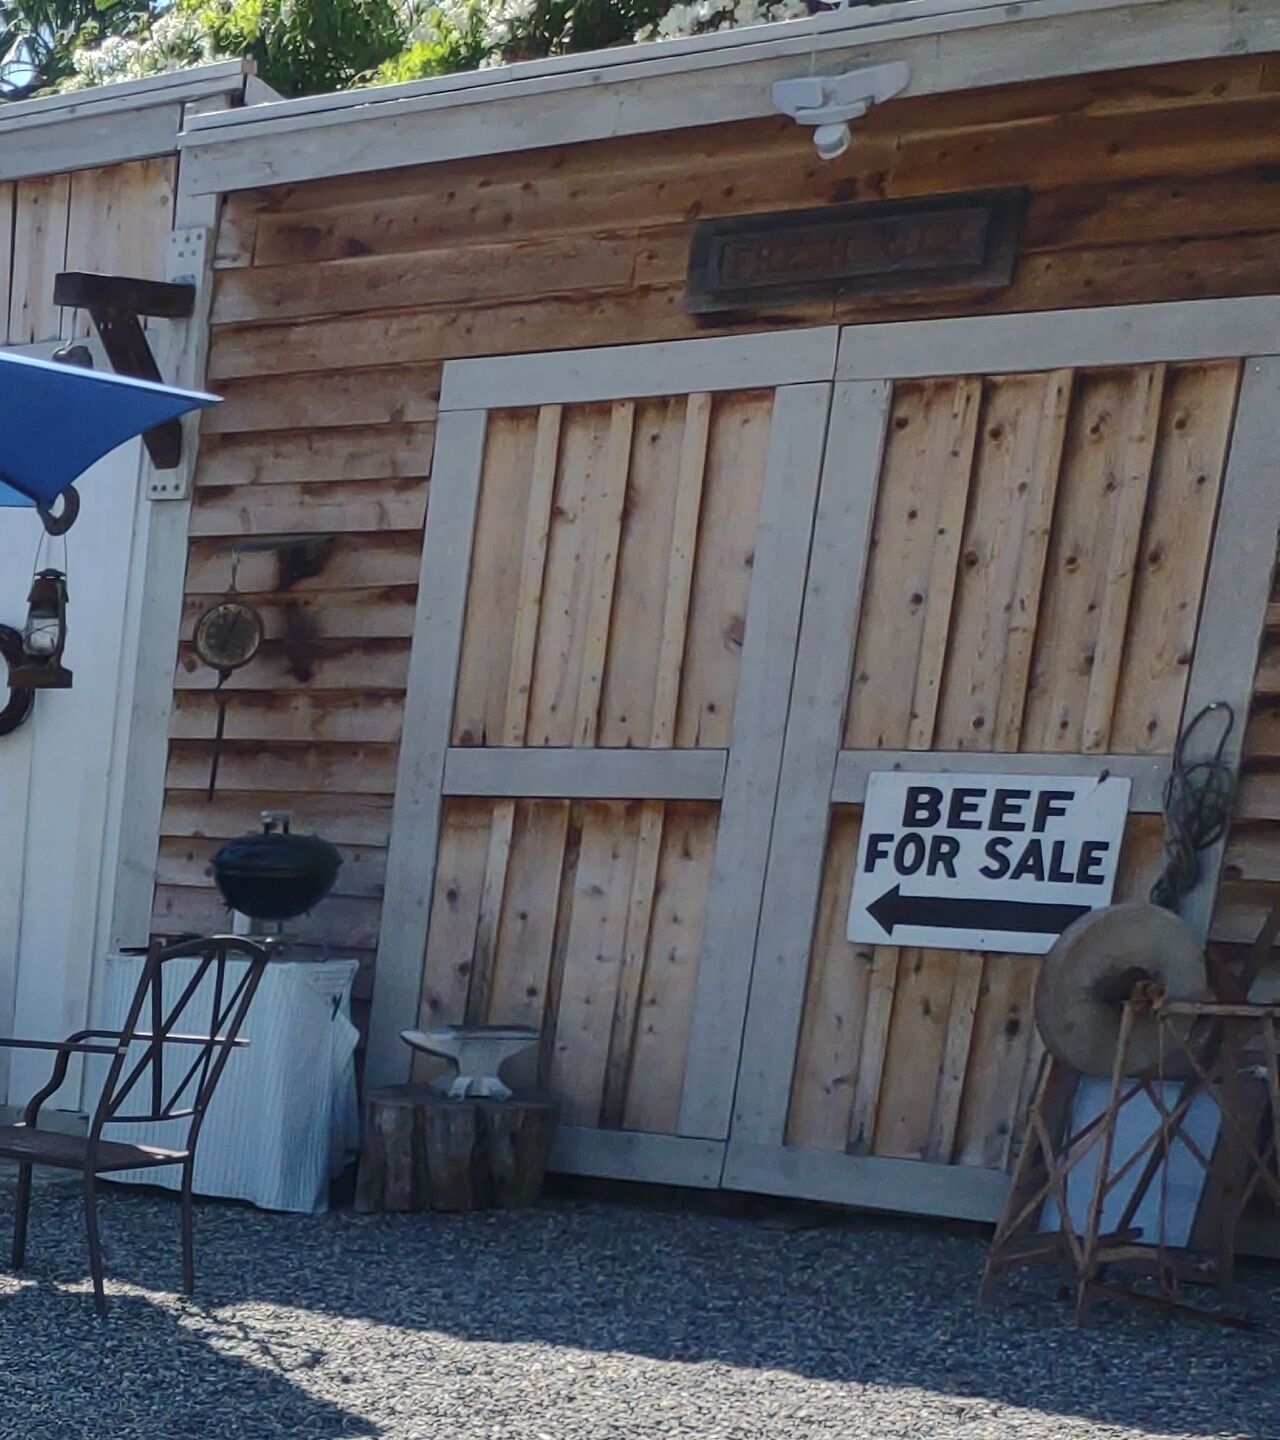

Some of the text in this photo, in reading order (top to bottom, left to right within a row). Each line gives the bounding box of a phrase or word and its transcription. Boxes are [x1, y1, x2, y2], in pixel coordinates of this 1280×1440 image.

[902, 787, 1075, 832] BEEF
[864, 832, 1110, 885] FOR SALE
